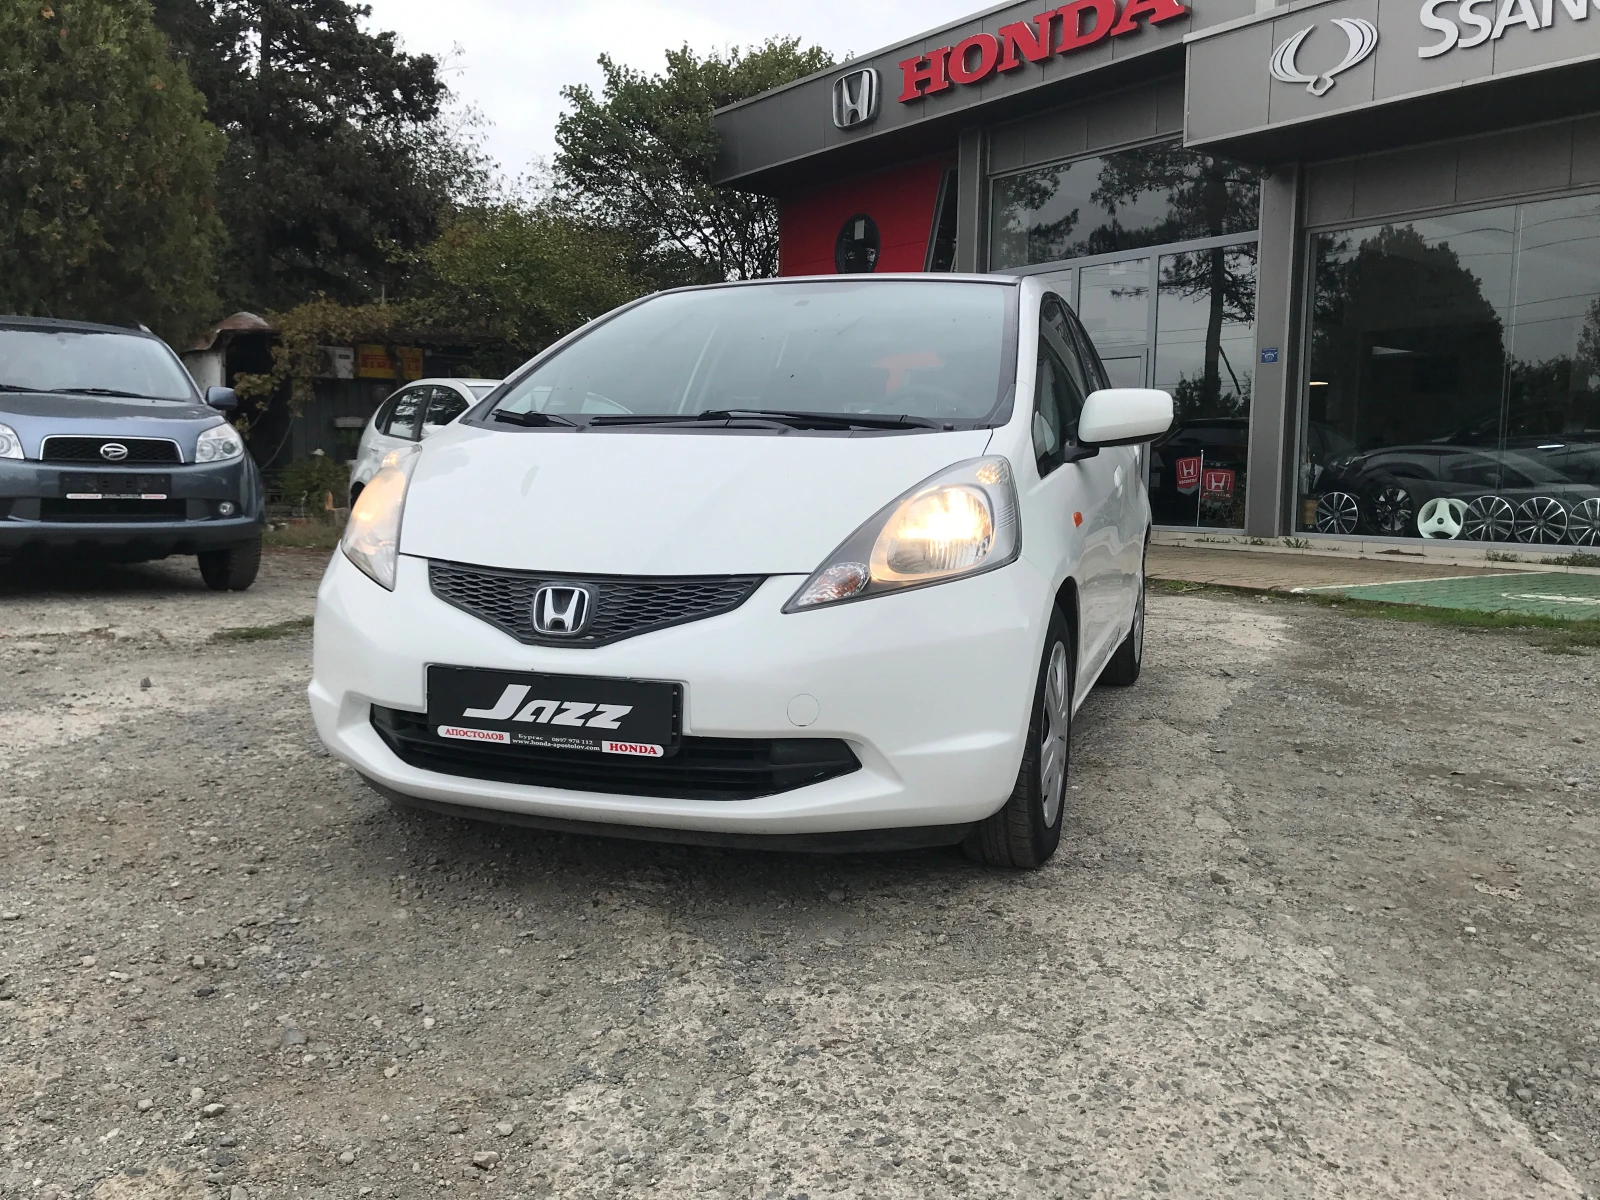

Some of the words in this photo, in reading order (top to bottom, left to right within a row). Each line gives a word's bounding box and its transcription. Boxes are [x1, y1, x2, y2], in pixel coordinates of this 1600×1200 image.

[898, 0, 1190, 103] HONDA
[444, 728, 505, 741] АПОСТОЛОВ
[512, 739, 600, 751] www.honda-apostolov.com
[609, 743, 658, 755] HONDA
